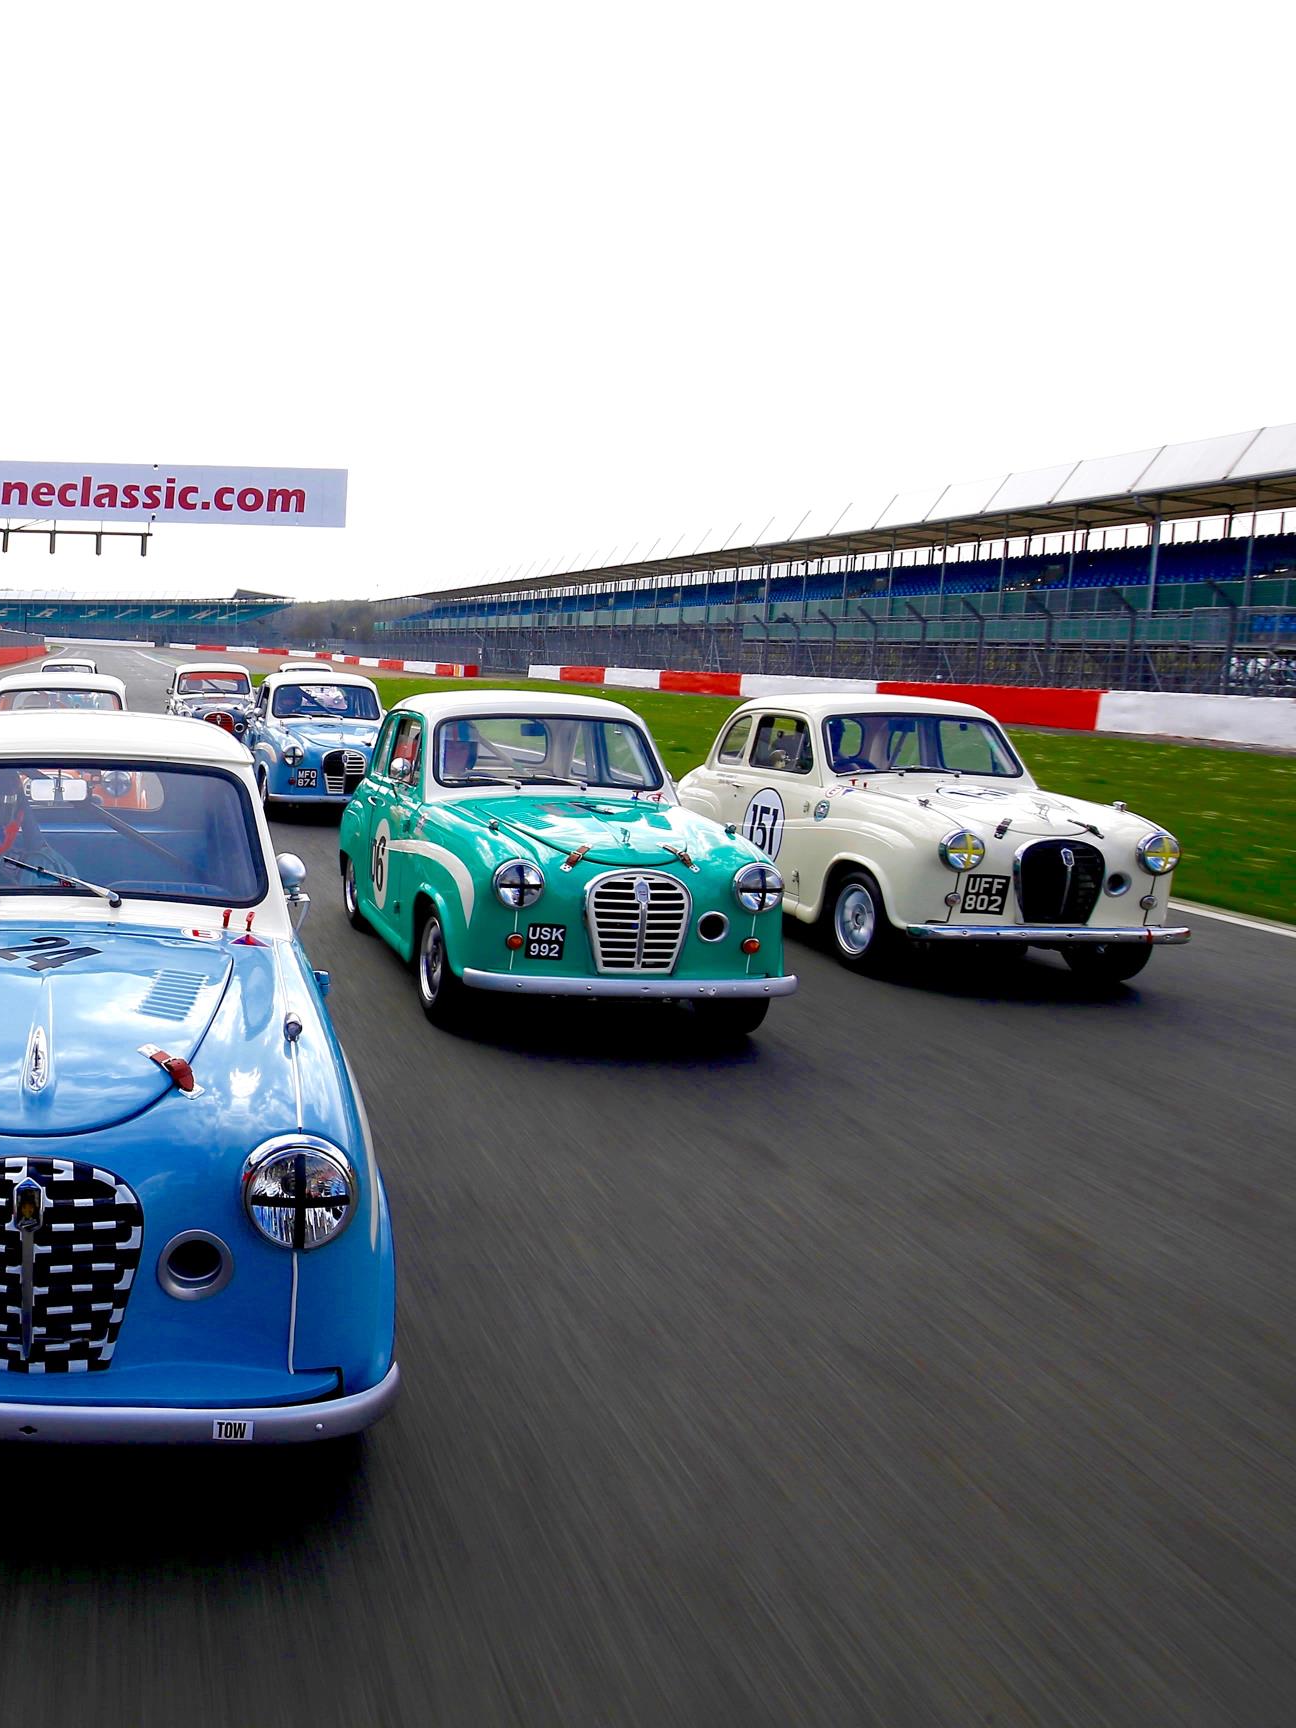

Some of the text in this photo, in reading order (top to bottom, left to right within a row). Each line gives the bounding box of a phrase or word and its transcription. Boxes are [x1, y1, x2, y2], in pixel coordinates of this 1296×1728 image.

[298, 770, 317, 779] MFO
[297, 779, 316, 787] 874
[749, 804, 779, 855] 151
[967, 877, 1006, 895] UFF
[964, 894, 1002, 912] 802
[528, 926, 565, 942] USK
[529, 943, 560, 957] 992
[217, 1421, 247, 1438] TOW
